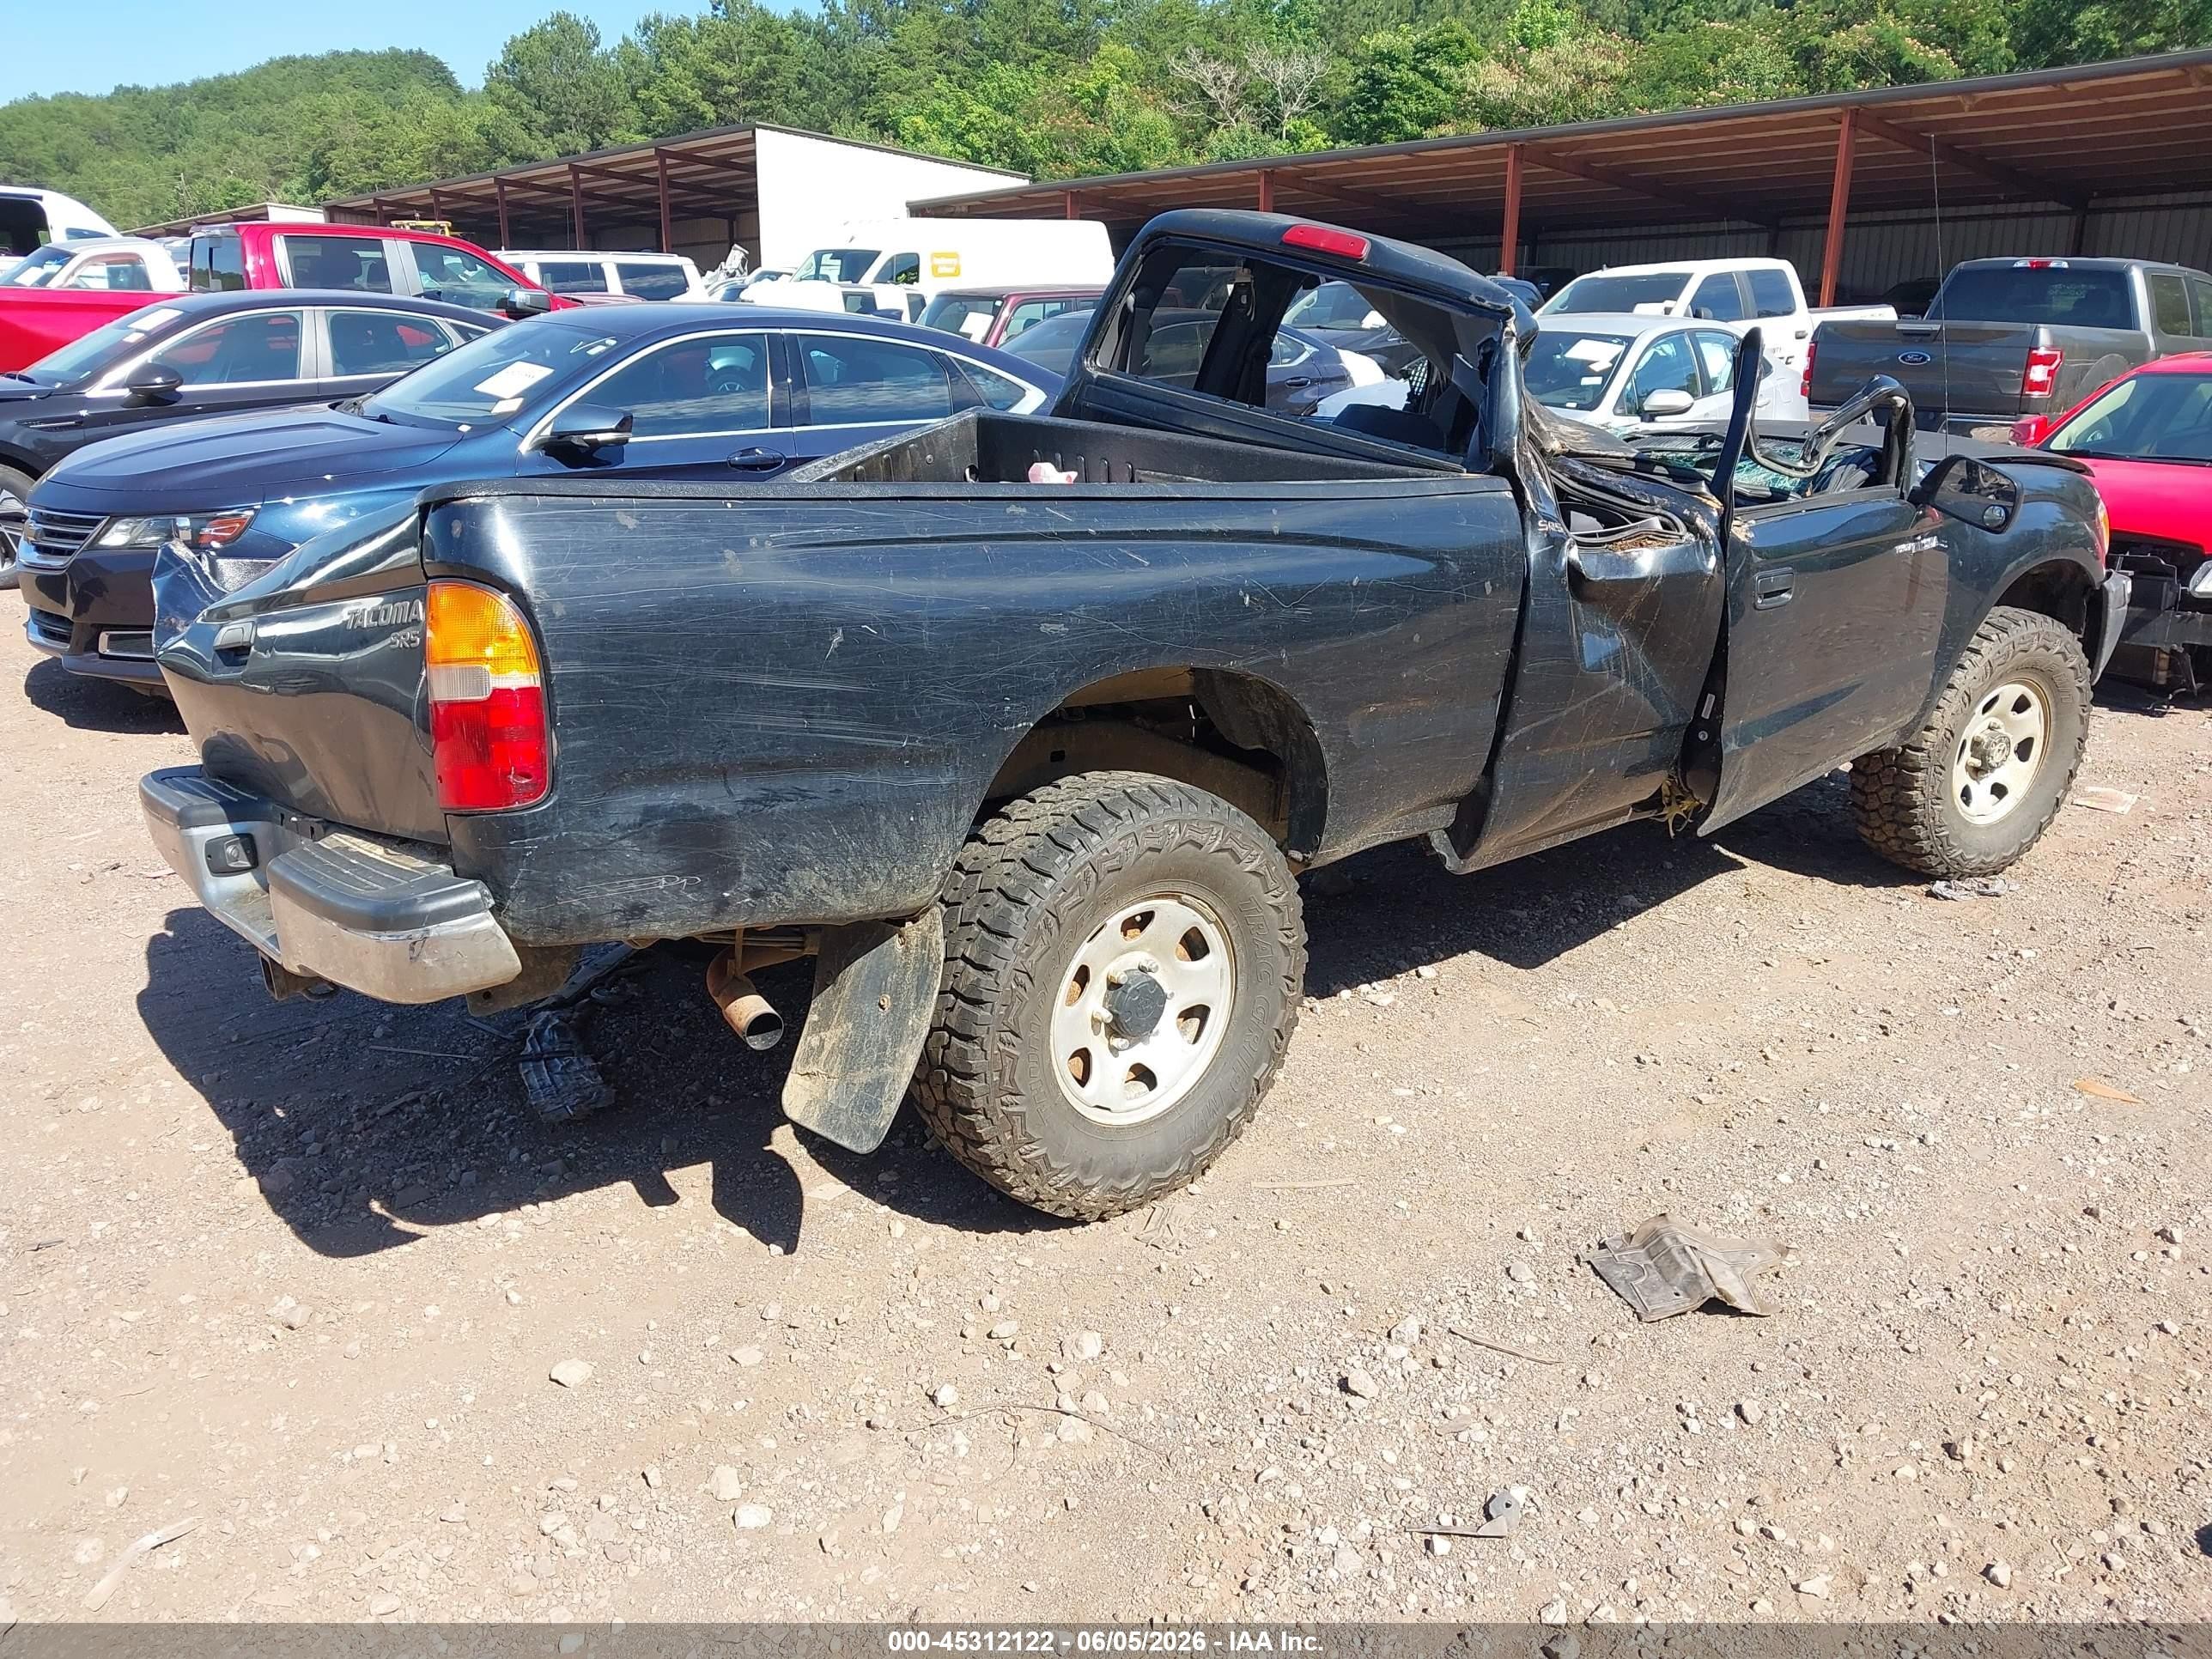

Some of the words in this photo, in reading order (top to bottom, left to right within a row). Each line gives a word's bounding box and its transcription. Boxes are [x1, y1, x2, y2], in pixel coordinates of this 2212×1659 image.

[345, 599, 424, 629] TACOMA
[1239, 896, 1277, 986] TRAC
[1227, 994, 1272, 1094] GRIP
